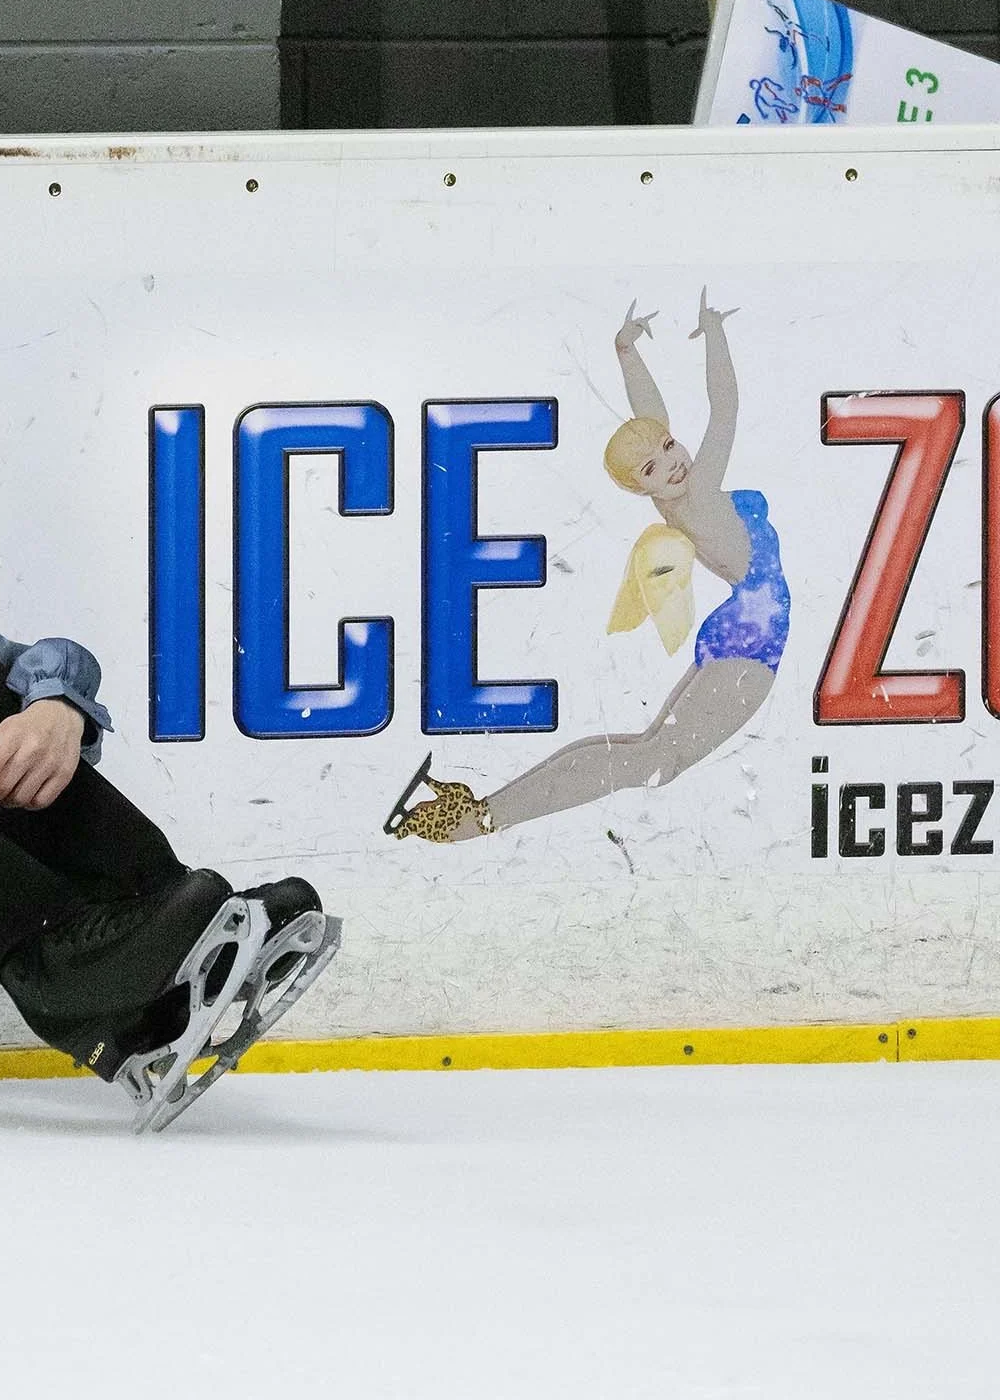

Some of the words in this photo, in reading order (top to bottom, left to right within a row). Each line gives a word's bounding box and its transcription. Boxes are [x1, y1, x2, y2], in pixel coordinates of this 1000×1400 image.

[905, 68, 939, 94] 3
[148, 397, 559, 742] ICE
[811, 755, 995, 858] icez
